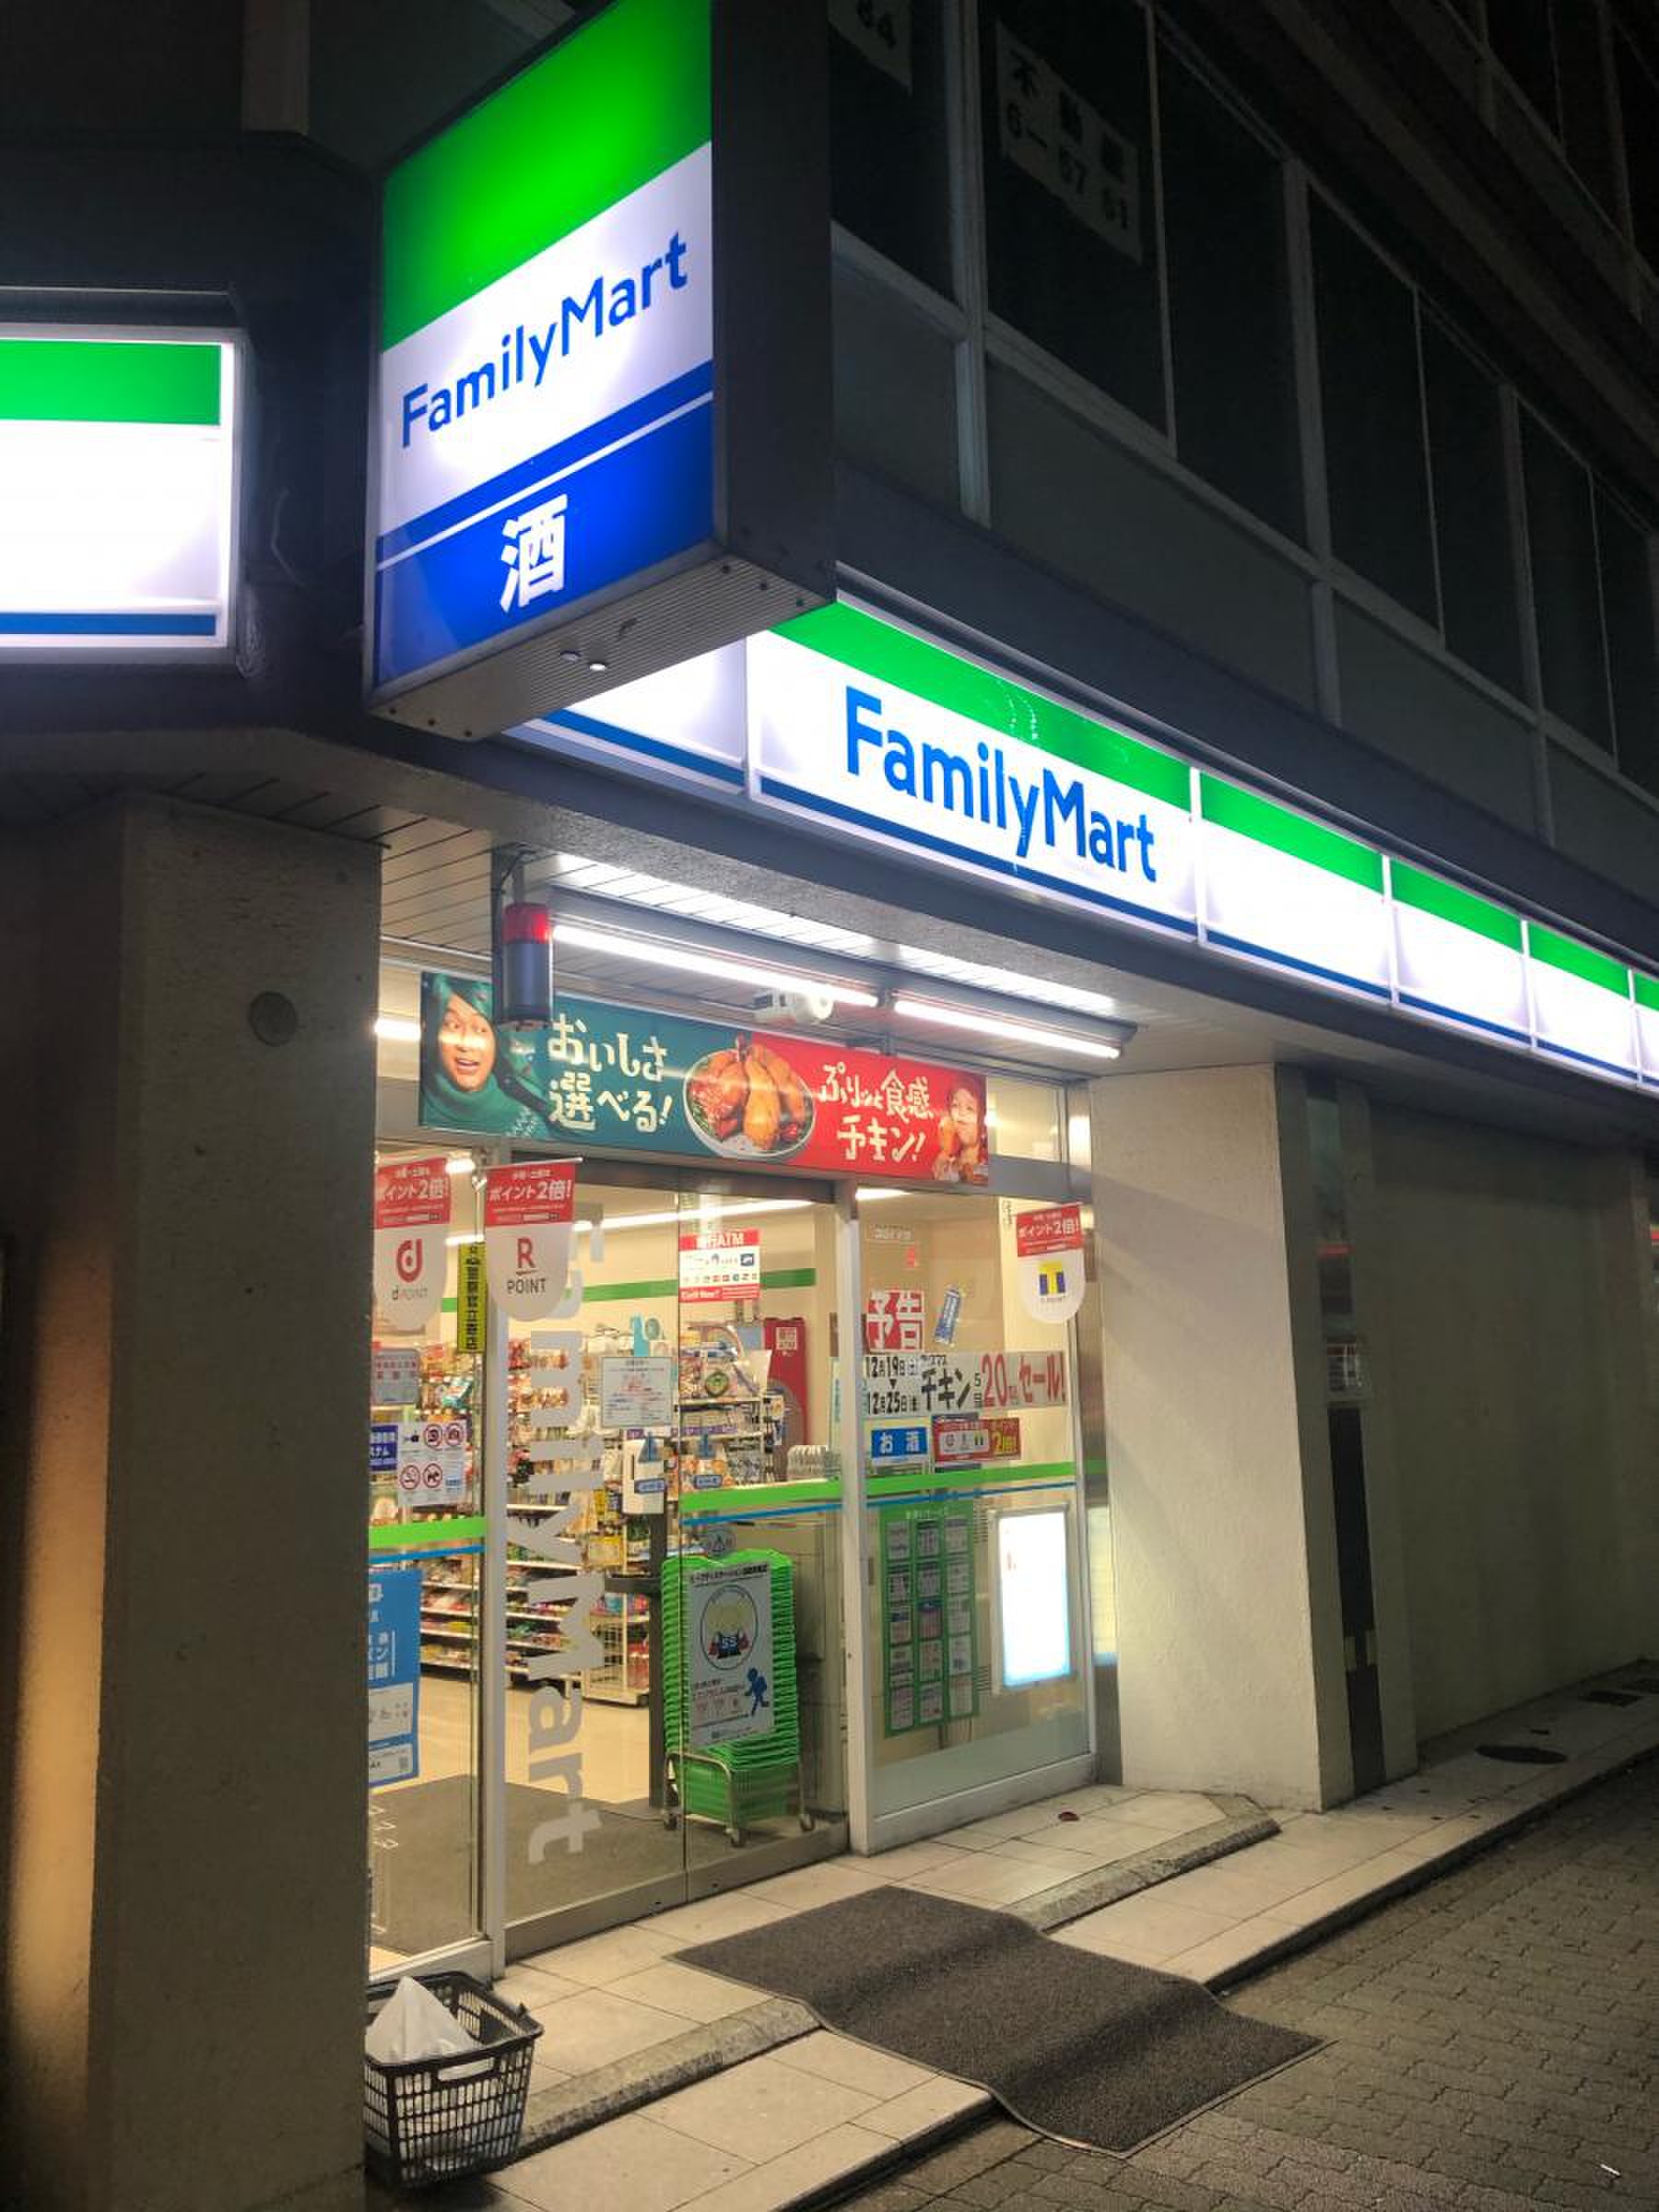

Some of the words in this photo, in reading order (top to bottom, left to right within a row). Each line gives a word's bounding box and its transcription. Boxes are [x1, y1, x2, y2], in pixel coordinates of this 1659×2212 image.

[402, 231, 688, 449] FamilyMart
[500, 494, 568, 613] 酒
[846, 685, 1157, 883] FamilyMart
[547, 1013, 667, 1082] おいしさ
[818, 1061, 935, 1124] ぷりっと食感
[517, 1238, 535, 1268] R
[507, 1278, 547, 1295] POINT
[866, 1288, 925, 1351] 予告
[879, 1430, 920, 1453] お酒
